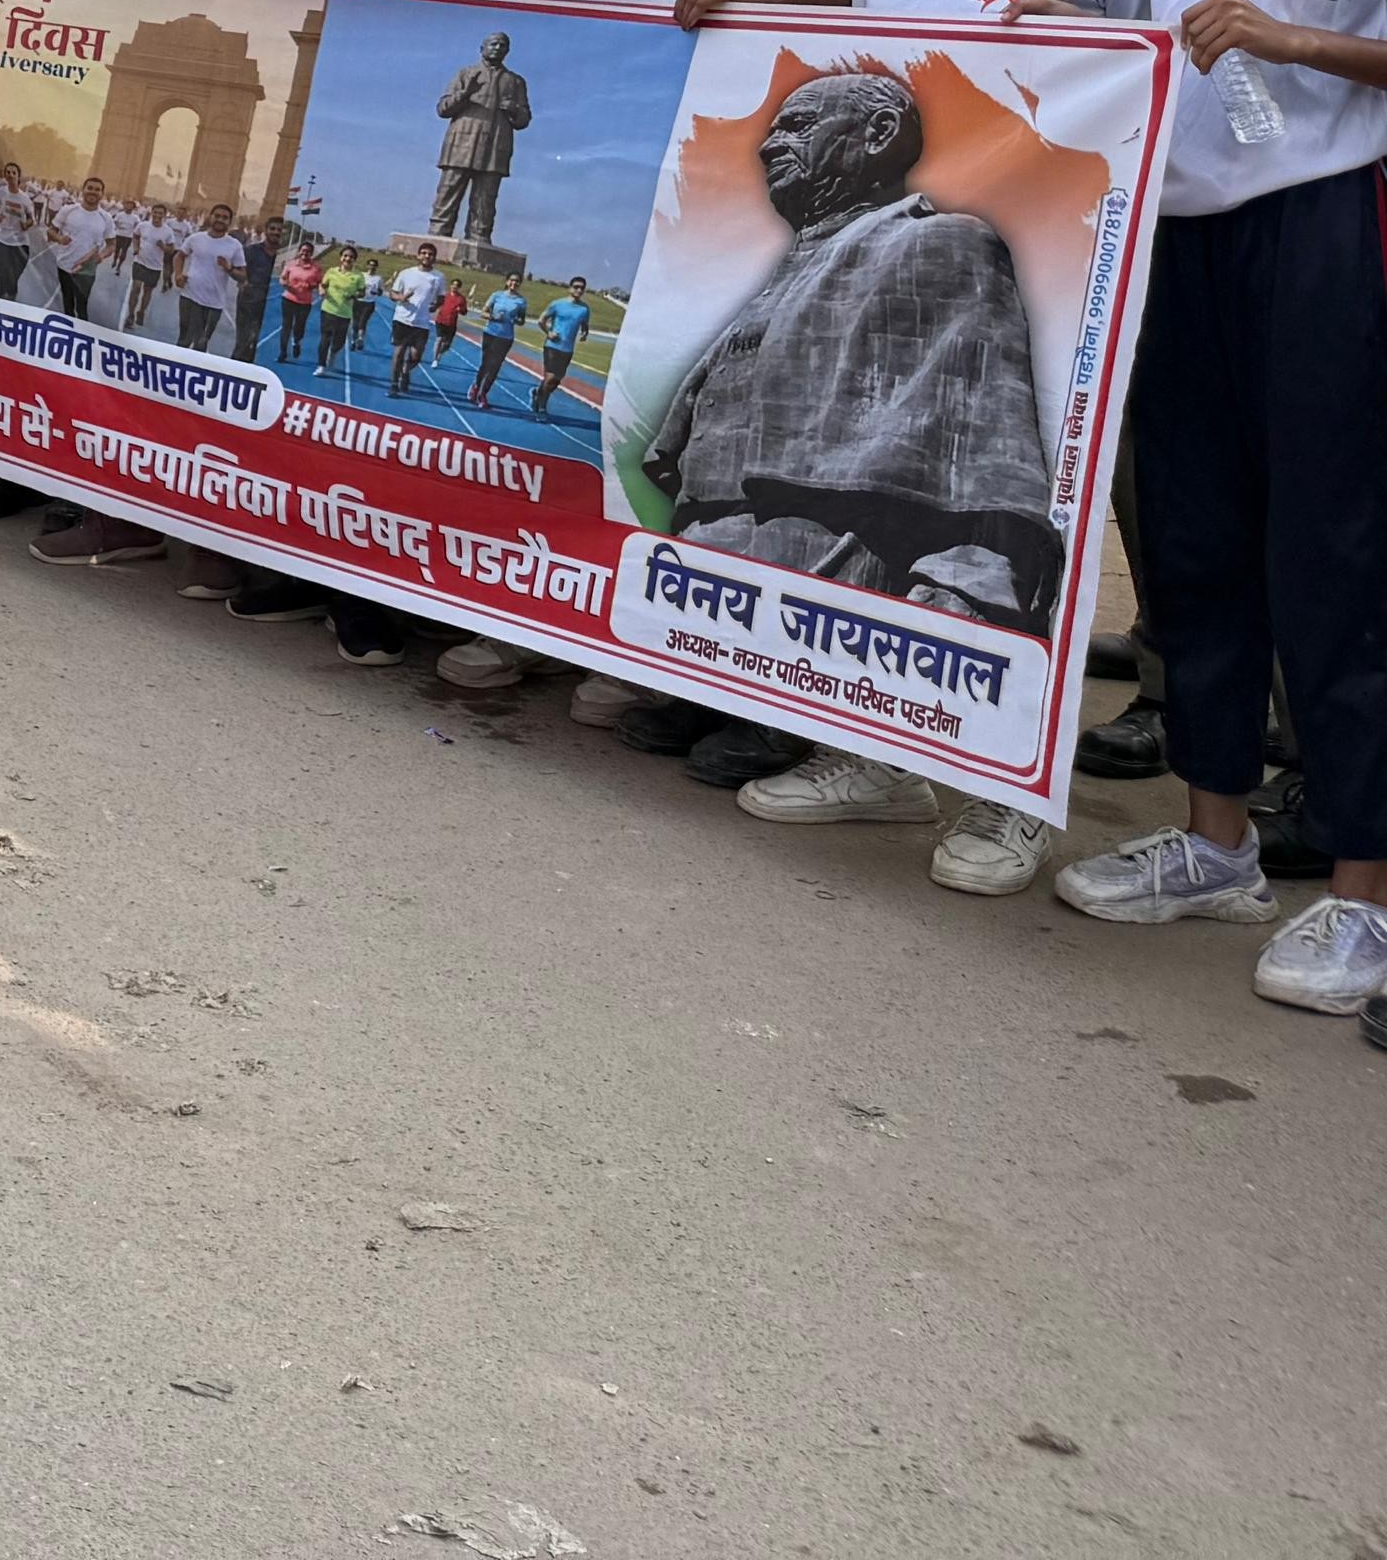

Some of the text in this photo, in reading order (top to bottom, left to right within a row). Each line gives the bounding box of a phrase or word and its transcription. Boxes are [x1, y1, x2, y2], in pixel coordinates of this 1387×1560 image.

[3, 5, 112, 64] दिवस
[98, 340, 269, 423] सभासदगण
[282, 398, 546, 504] #RunForUnity
[19, 393, 65, 451] से-
[70, 416, 294, 529] नगरपालिका
[295, 482, 437, 585] परिषद्
[437, 526, 614, 618] पडरौना
[643, 542, 1011, 708] विनय जायसवाल
[732, 644, 775, 680] नगर
[775, 658, 841, 699] पालिका
[842, 677, 897, 720] परिषद
[900, 699, 962, 741] पडरौना
